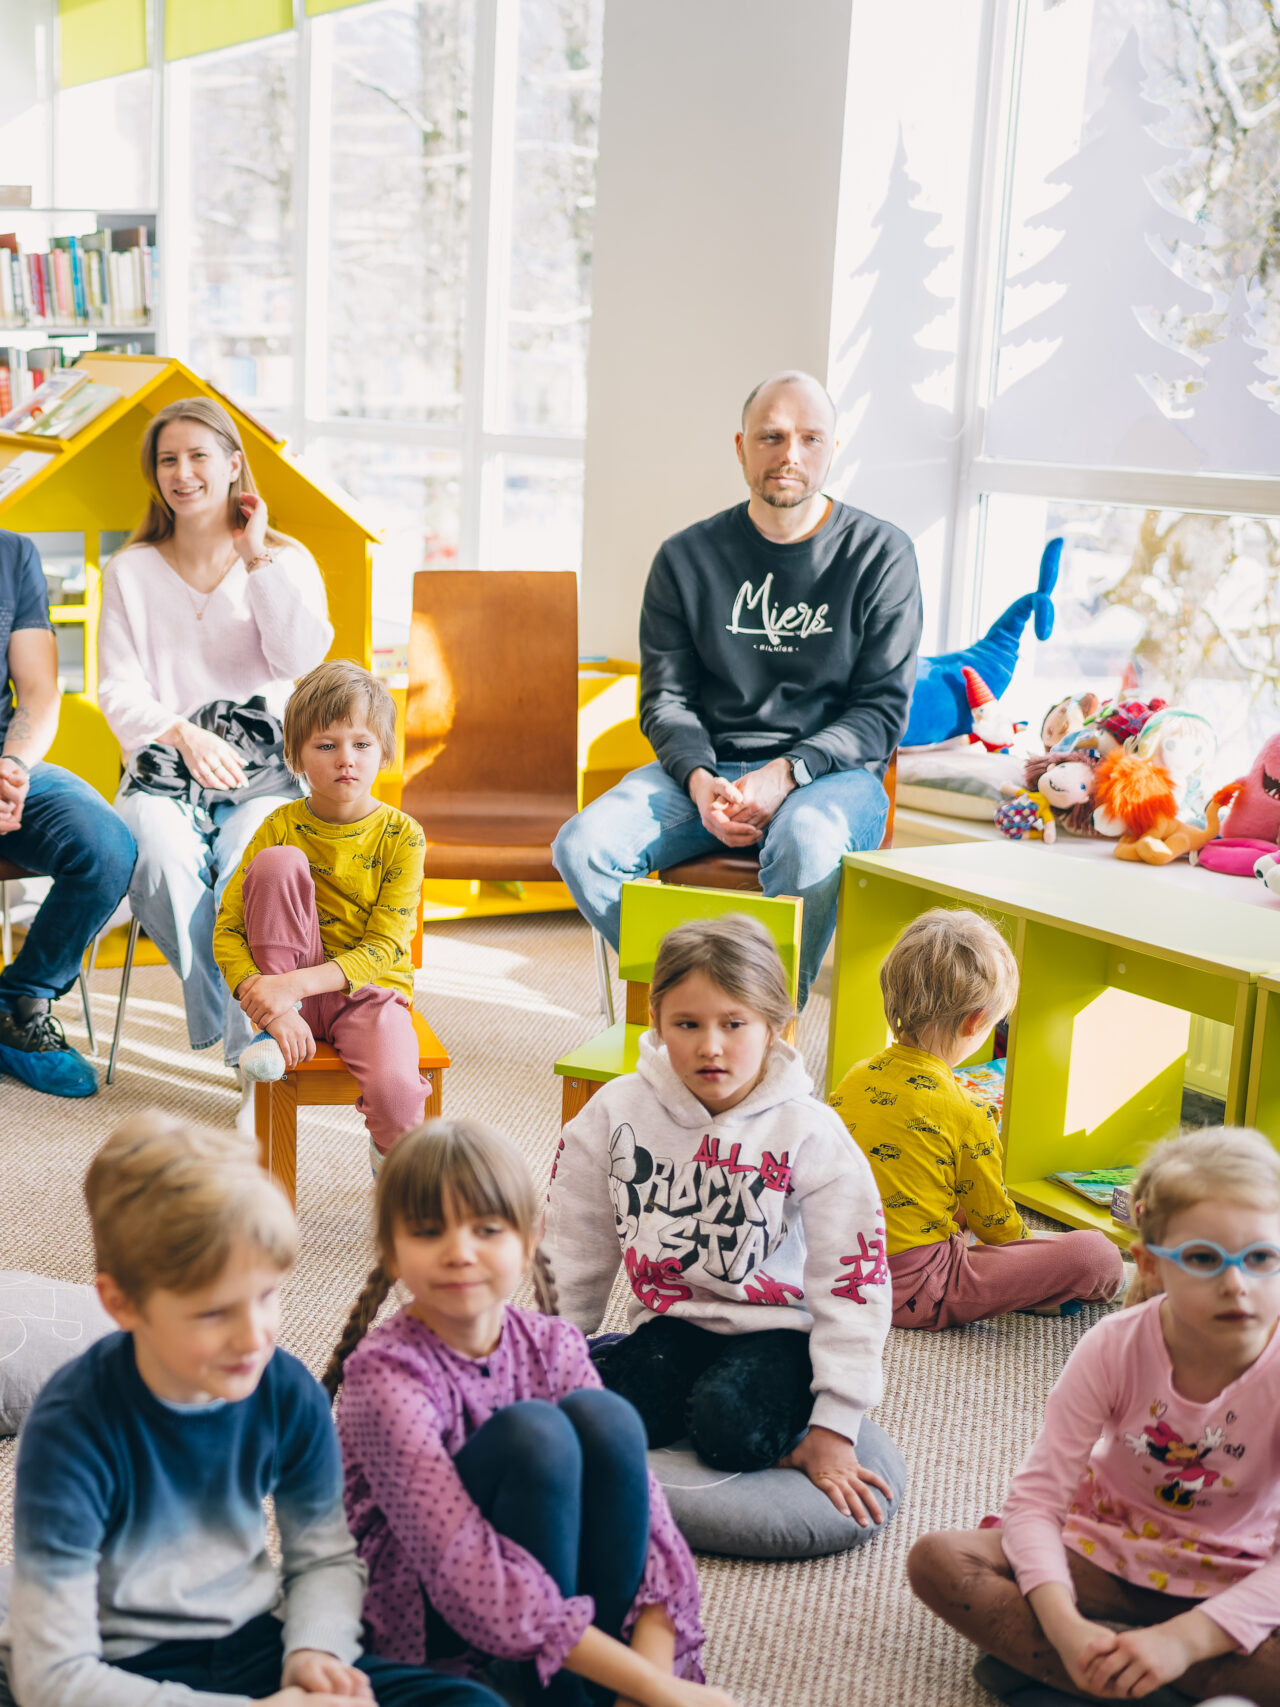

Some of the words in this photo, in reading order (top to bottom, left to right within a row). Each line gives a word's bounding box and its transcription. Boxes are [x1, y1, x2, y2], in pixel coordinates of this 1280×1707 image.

[725, 572, 833, 645] Miers
[692, 1133, 758, 1174] ALL
[643, 1156, 767, 1227] ROCK
[656, 1214, 788, 1284] STA
